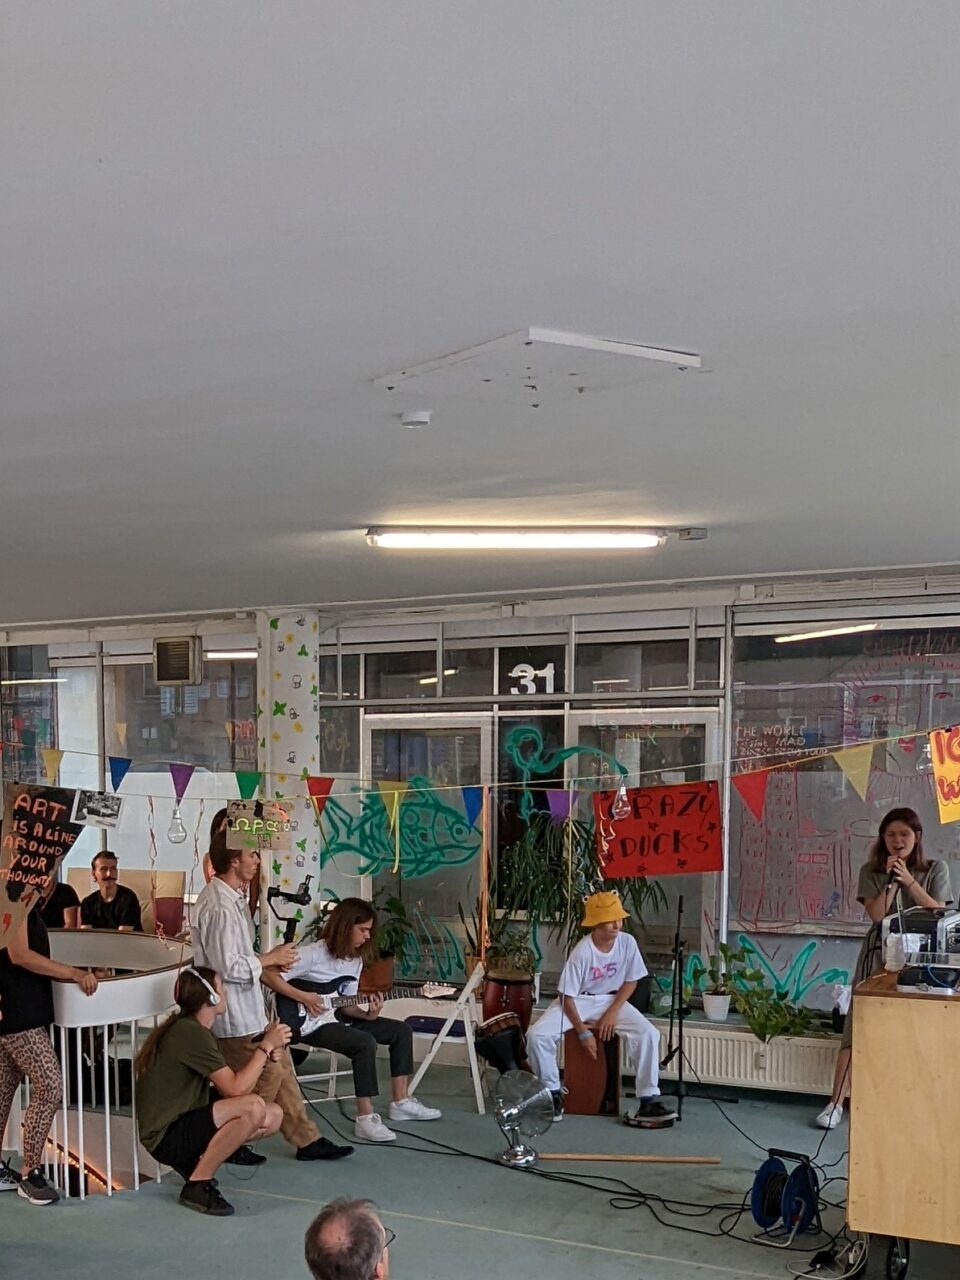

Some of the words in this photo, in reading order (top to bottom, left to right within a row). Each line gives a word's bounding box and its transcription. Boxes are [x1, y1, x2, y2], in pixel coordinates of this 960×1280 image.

[509, 662, 556, 695] 31
[14, 793, 67, 821] ART
[33, 822, 43, 838] A
[3, 835, 63, 856] AROUND
[619, 829, 710, 858] DUCKS
[9, 851, 48, 872] YOUR
